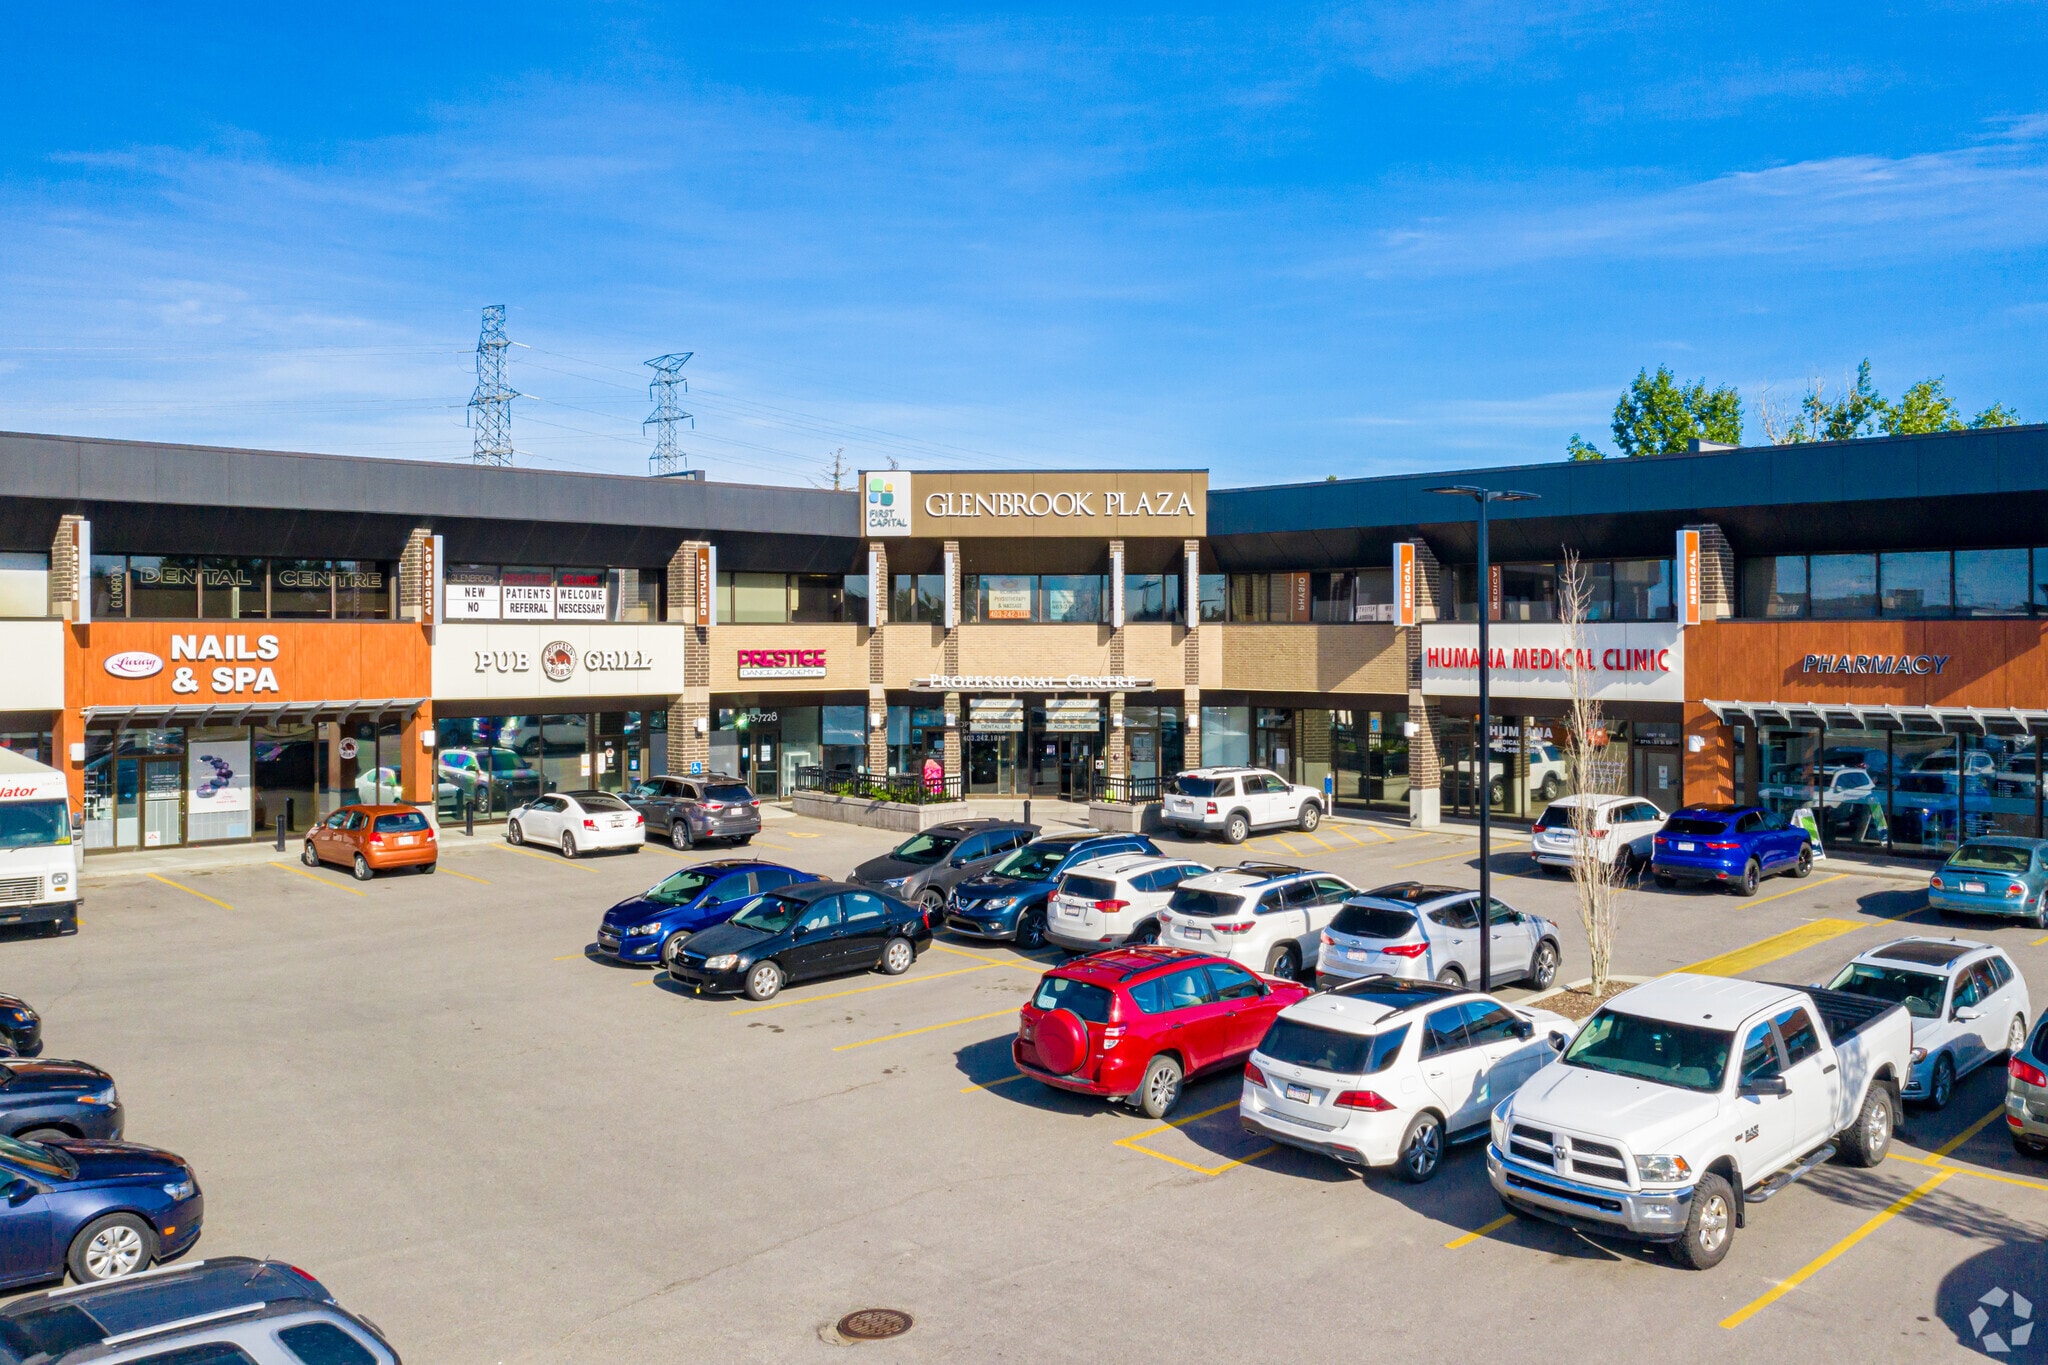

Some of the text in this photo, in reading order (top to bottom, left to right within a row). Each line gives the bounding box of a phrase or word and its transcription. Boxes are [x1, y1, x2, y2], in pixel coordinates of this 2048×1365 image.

[925, 491, 1196, 517] GLENBROOK PLAZA
[869, 509, 895, 518] FIRST
[869, 518, 908, 528] CAPITAL
[140, 566, 252, 586] DENTAL
[279, 570, 383, 588] CENTRE
[562, 573, 599, 586] CLINIC
[111, 565, 123, 608] GLENBROOK
[465, 587, 485, 597] NEW
[506, 588, 551, 599] PATIENTS
[560, 589, 603, 600] WELCOME
[468, 602, 479, 612] NO
[510, 603, 548, 613] REFERRAL
[558, 603, 605, 614] NESCESSARY
[171, 634, 280, 661] NAILS
[111, 656, 156, 673] Luxury
[475, 650, 653, 672] PUB GRILL
[738, 649, 827, 667] PRESTIGE
[1603, 648, 1670, 672] CLINIC
[1803, 654, 1950, 675] PHARMACY
[171, 666, 280, 693] & SPA
[929, 674, 1137, 688] PROFESSIONAL CENTRE
